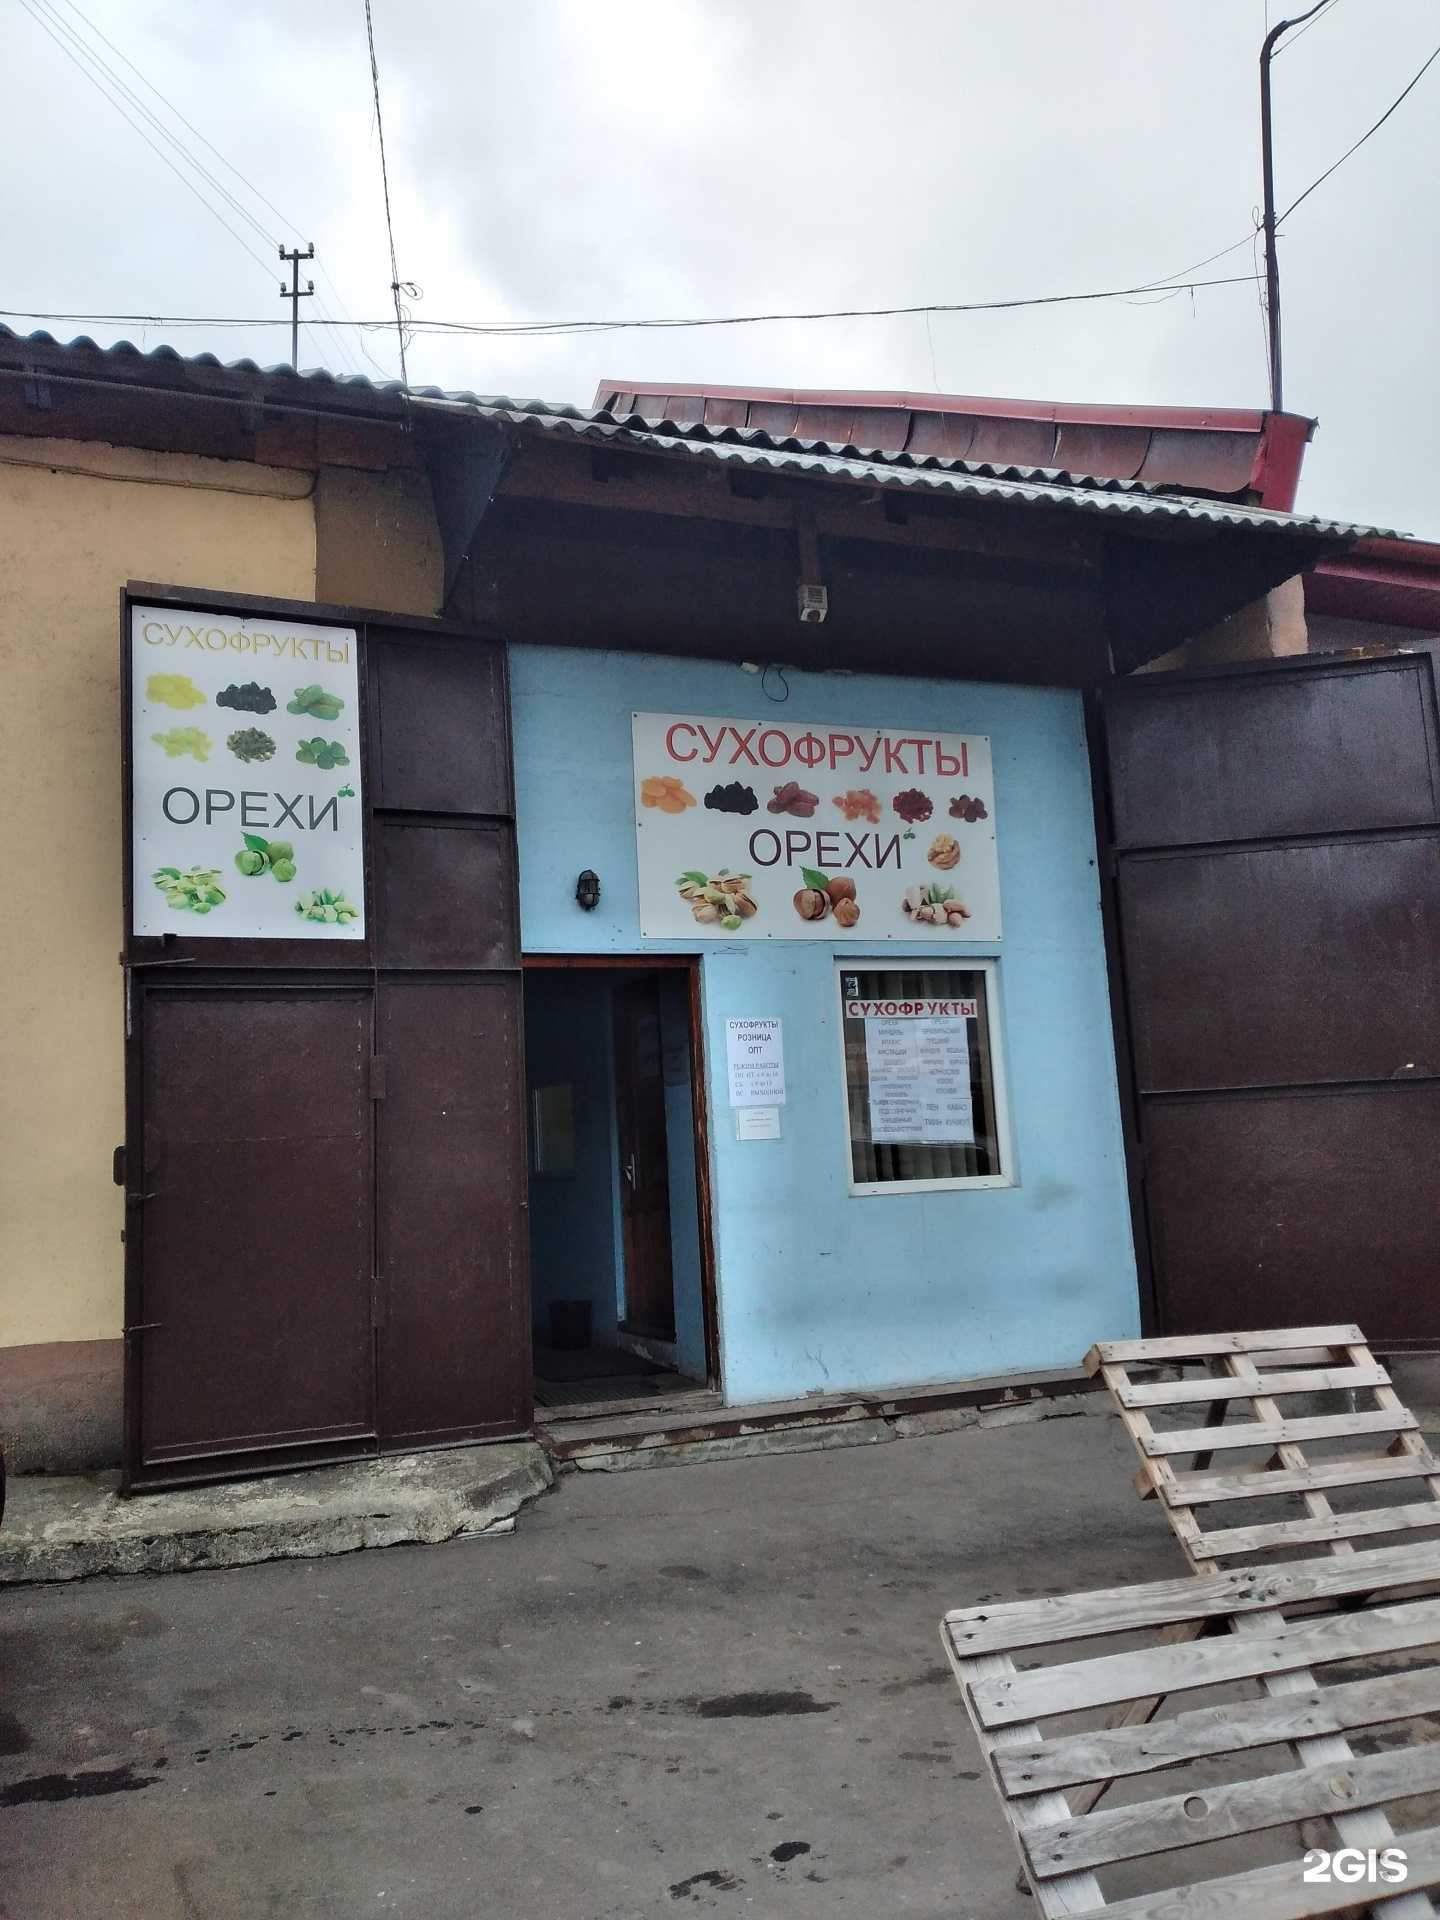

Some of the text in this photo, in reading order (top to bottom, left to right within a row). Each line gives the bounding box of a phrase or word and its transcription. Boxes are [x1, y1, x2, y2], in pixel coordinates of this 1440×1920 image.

[142, 622, 350, 665] СУХОФРУКТЫ
[665, 722, 969, 777] СУХОФРУКТЫ
[162, 786, 338, 832] ОРЕХИ
[748, 828, 902, 869] ОРЕХИ
[848, 1001, 975, 1017] СУХОФРУКТЫ
[729, 1020, 779, 1029] СУХОФРУКТЫ
[737, 1033, 772, 1042] РОЗНИЦА
[748, 1046, 763, 1054] ОПТ
